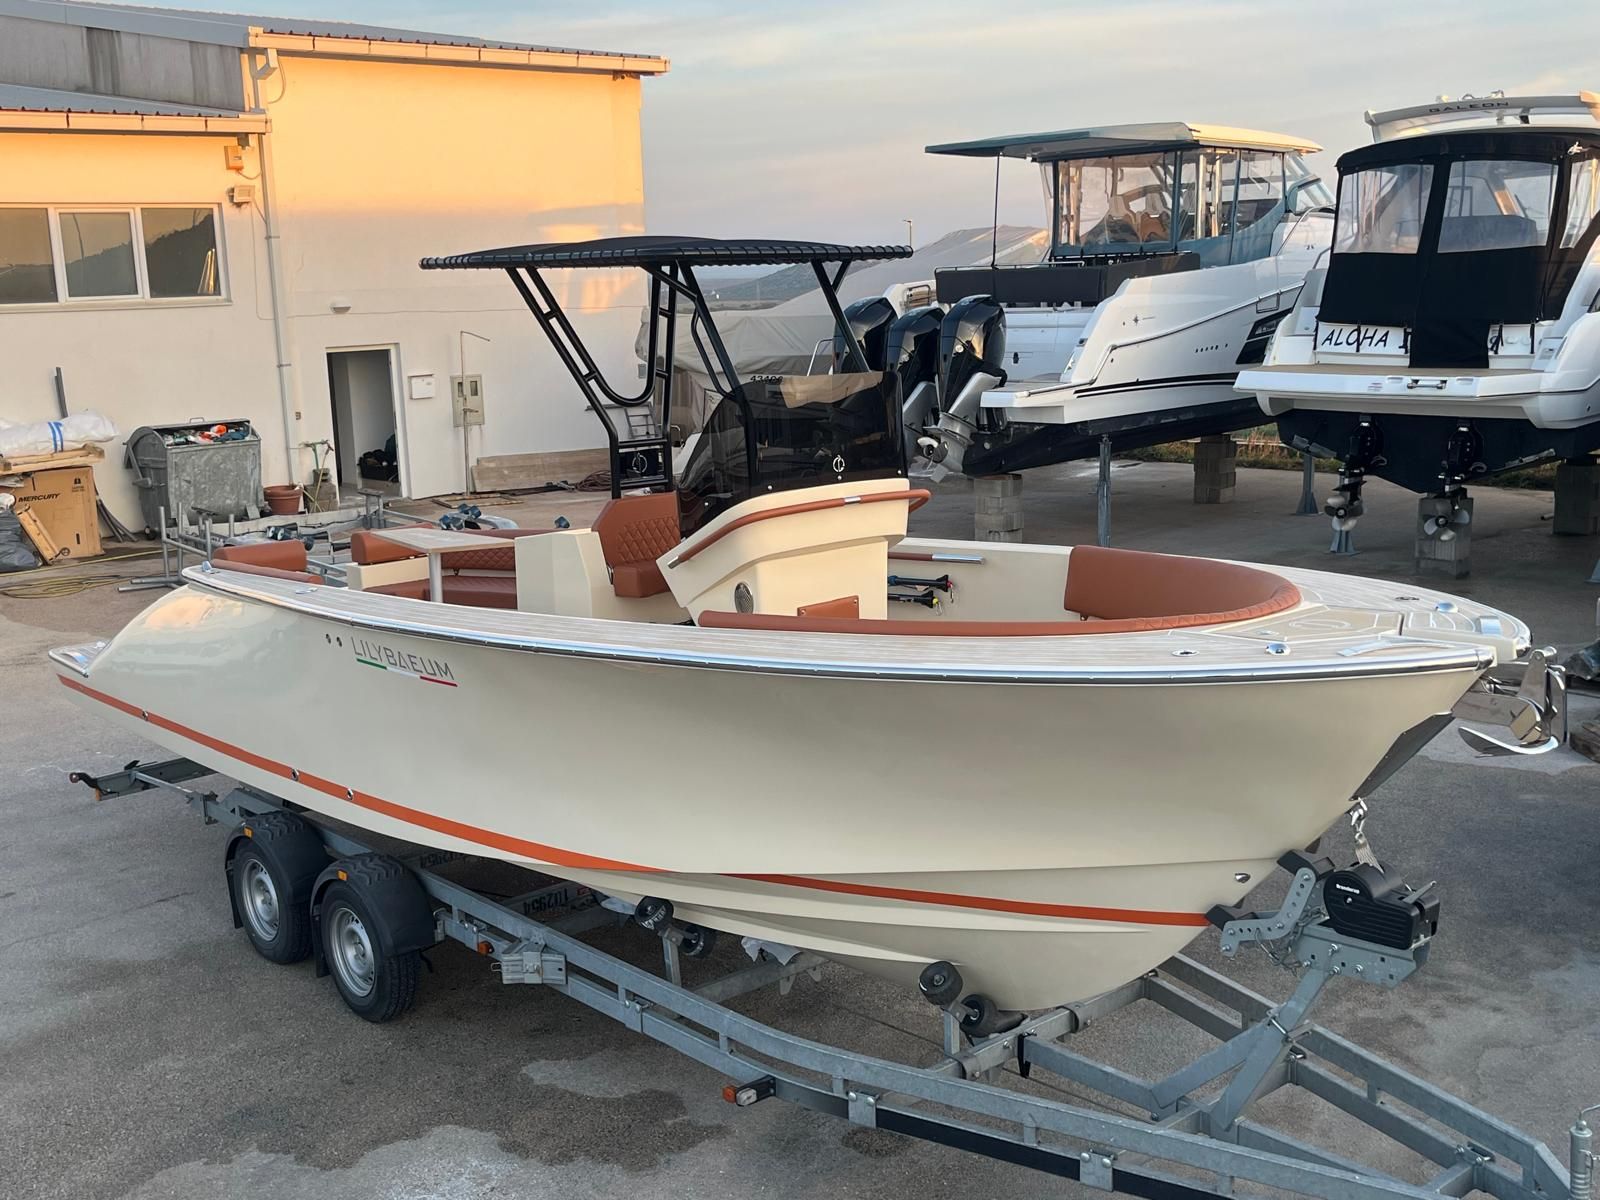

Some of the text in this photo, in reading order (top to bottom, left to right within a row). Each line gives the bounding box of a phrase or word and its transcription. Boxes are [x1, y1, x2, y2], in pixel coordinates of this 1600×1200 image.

[1428, 101, 1509, 113] GALEON
[1321, 327, 1391, 348] ALOHA
[18, 493, 61, 502] MERCURY
[350, 636, 455, 681] LILYBAEUM
